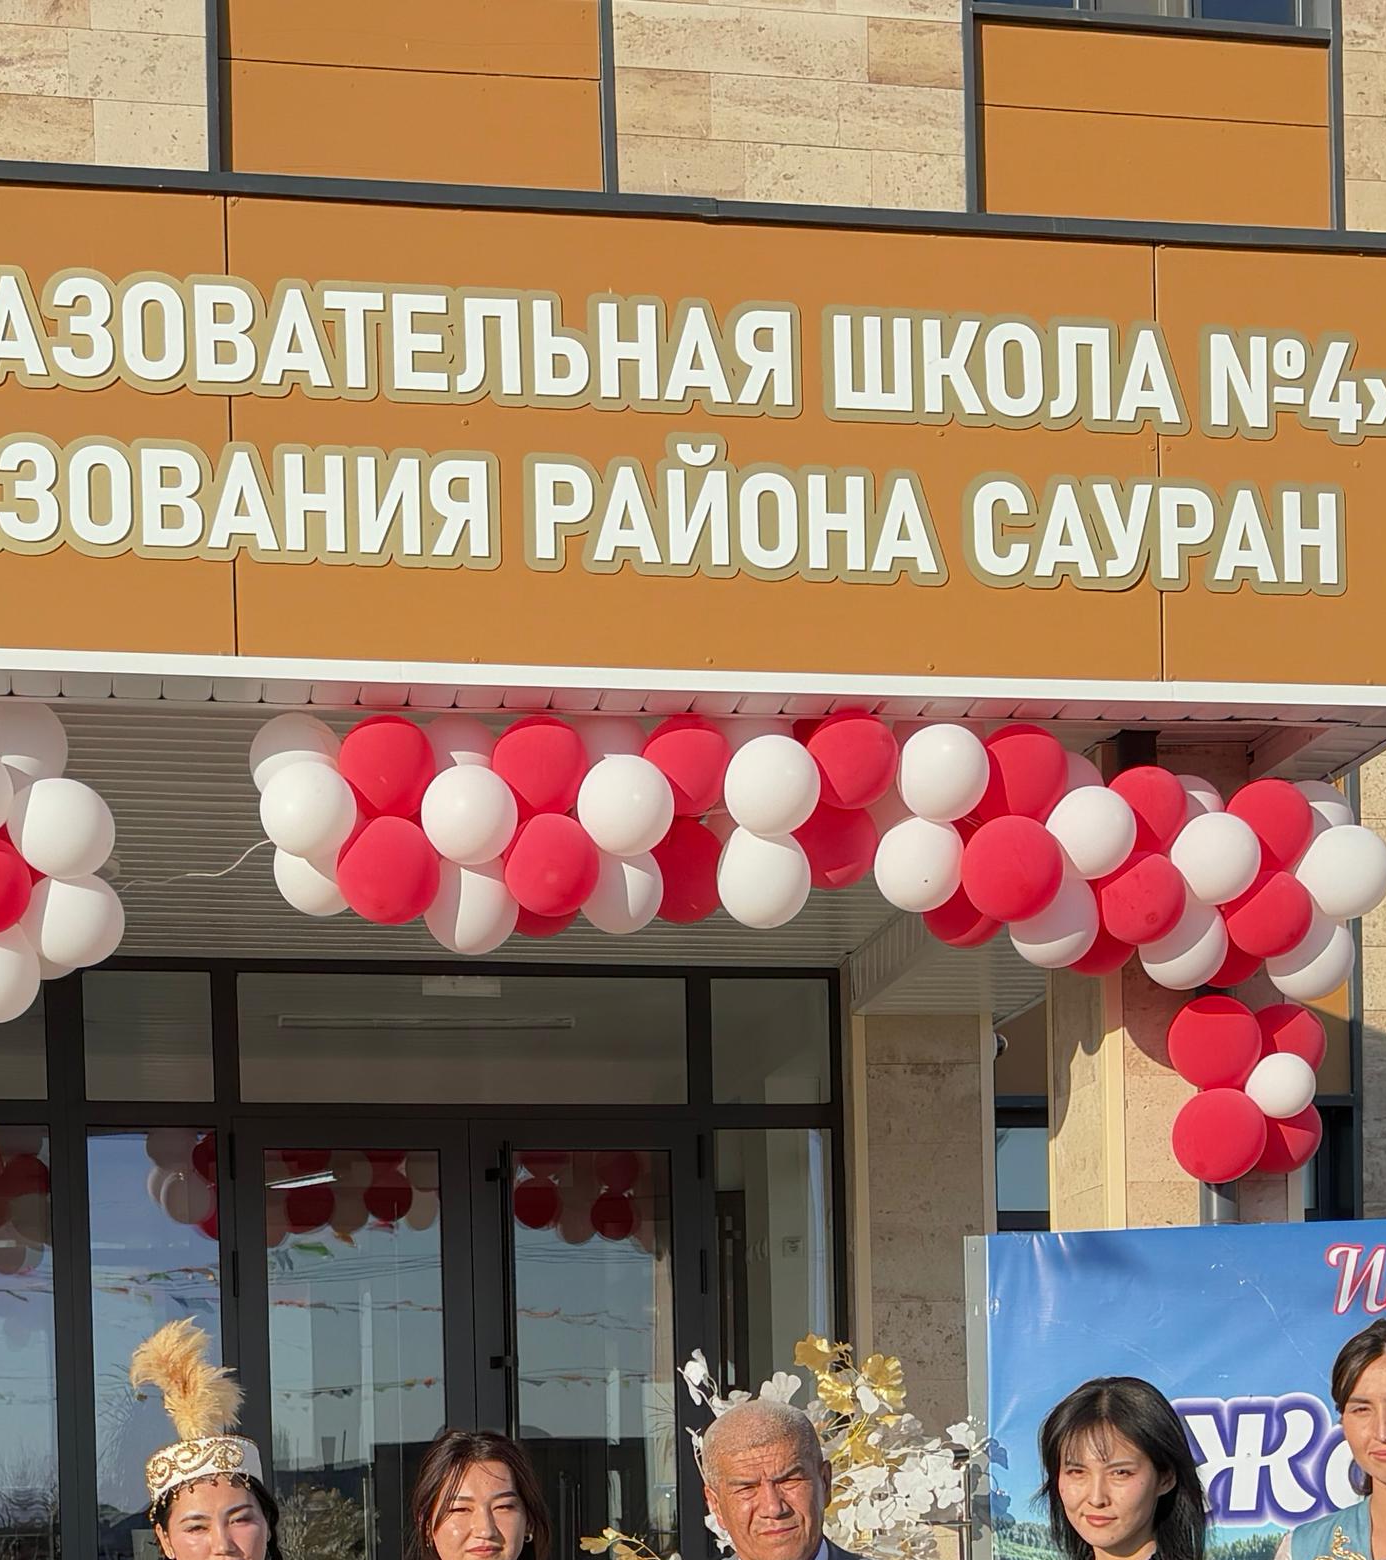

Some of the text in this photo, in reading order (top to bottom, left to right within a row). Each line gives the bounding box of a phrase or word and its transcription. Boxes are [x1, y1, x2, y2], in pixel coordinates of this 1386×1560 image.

[831, 313, 1182, 424] ШКОЛА
[533, 442, 939, 574] РАЙОНА
[971, 479, 1339, 585] САУРАН
